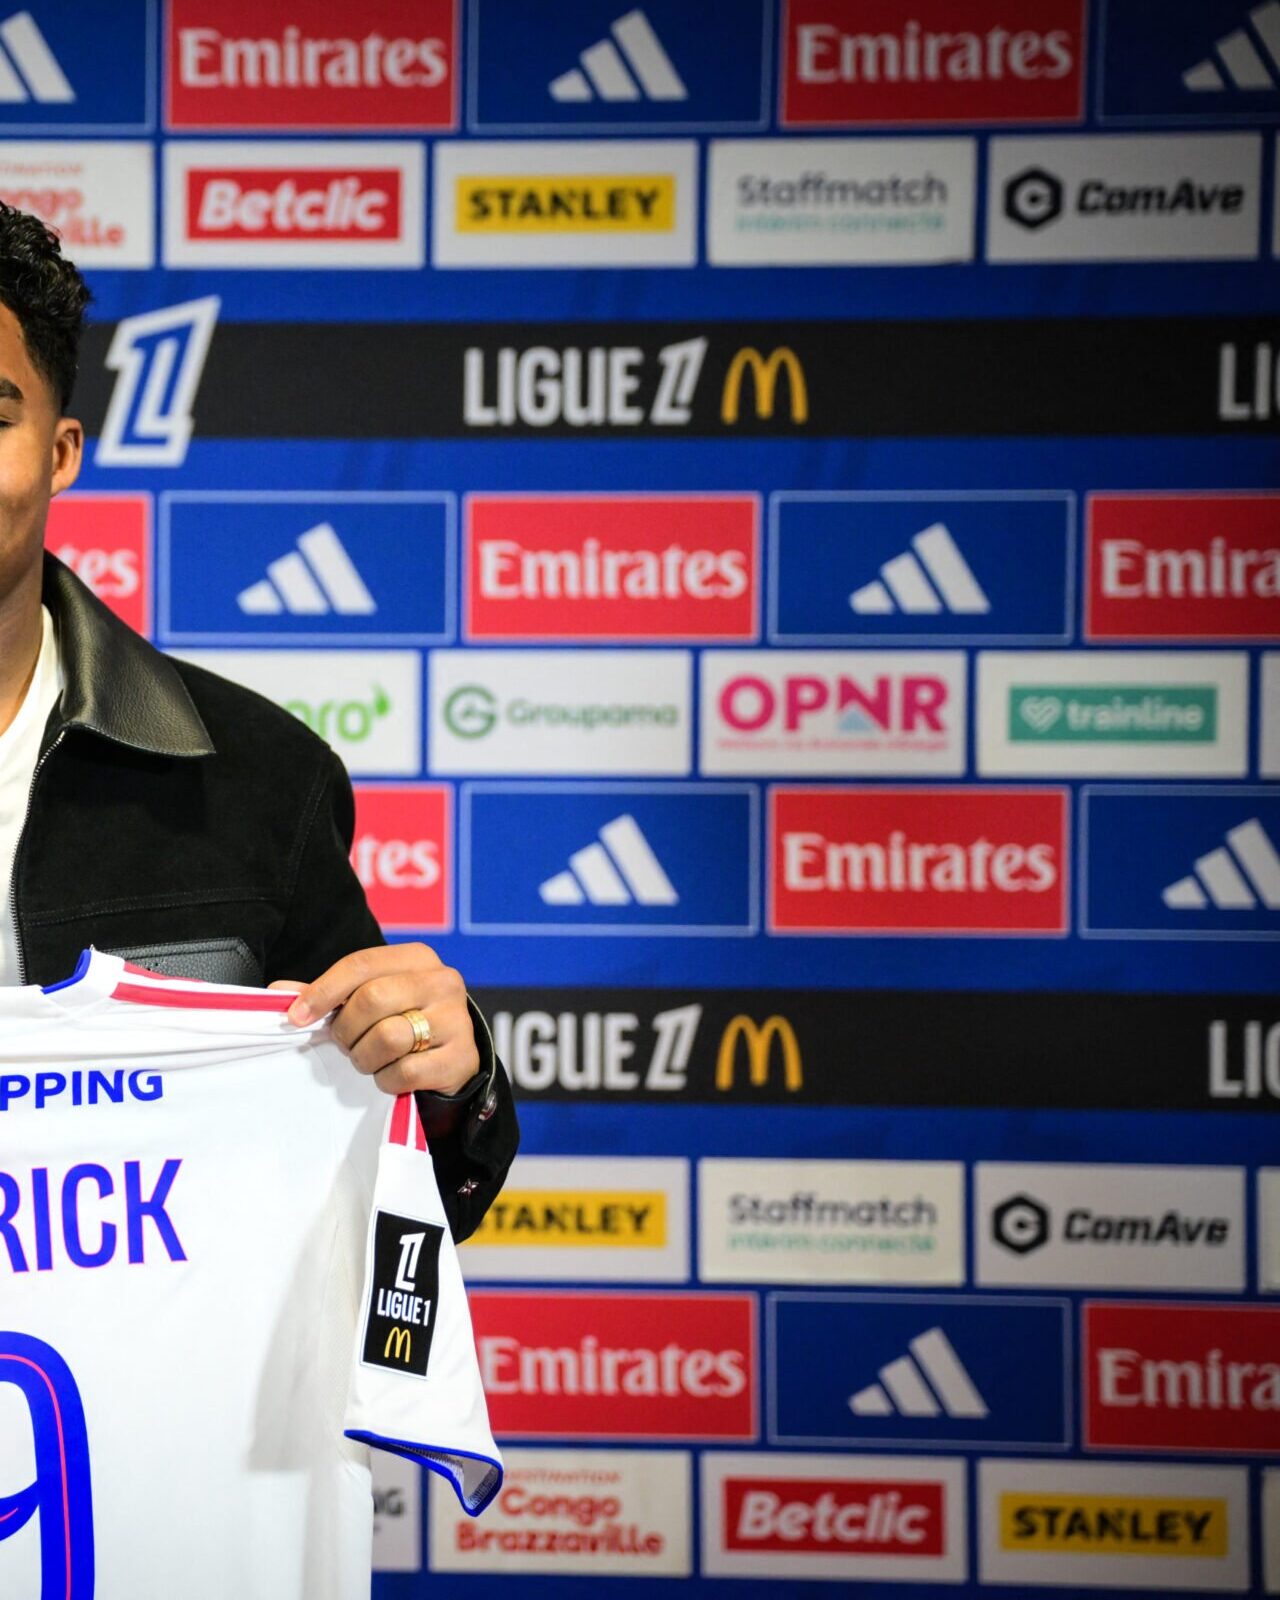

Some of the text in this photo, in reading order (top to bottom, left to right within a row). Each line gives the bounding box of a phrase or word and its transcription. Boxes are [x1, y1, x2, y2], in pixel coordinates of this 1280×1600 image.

[179, 28, 446, 87] Emirates
[797, 22, 1071, 83] Emirates
[198, 179, 386, 230] Betclic
[470, 188, 659, 220] STANLEY
[739, 171, 949, 206] Staffmatch
[1077, 179, 1245, 214] ComAve
[464, 347, 642, 425] LIGUE
[479, 539, 746, 598] Emirates
[507, 700, 681, 730] Groupama
[719, 676, 948, 734] OPNR
[1067, 696, 1204, 731] trainline
[783, 832, 1055, 891] Emirates
[493, 1010, 640, 1090] IGUE
[730, 1194, 938, 1228] Staffmatch
[1064, 1210, 1229, 1246] ComAve
[377, 1287, 422, 1324] LIGUE
[479, 1335, 746, 1397] Emirates
[499, 1487, 623, 1526] Congo
[738, 1491, 927, 1542] Betclic
[1015, 1507, 1212, 1545] STANLEY
[456, 1521, 664, 1557] Brazzaville
